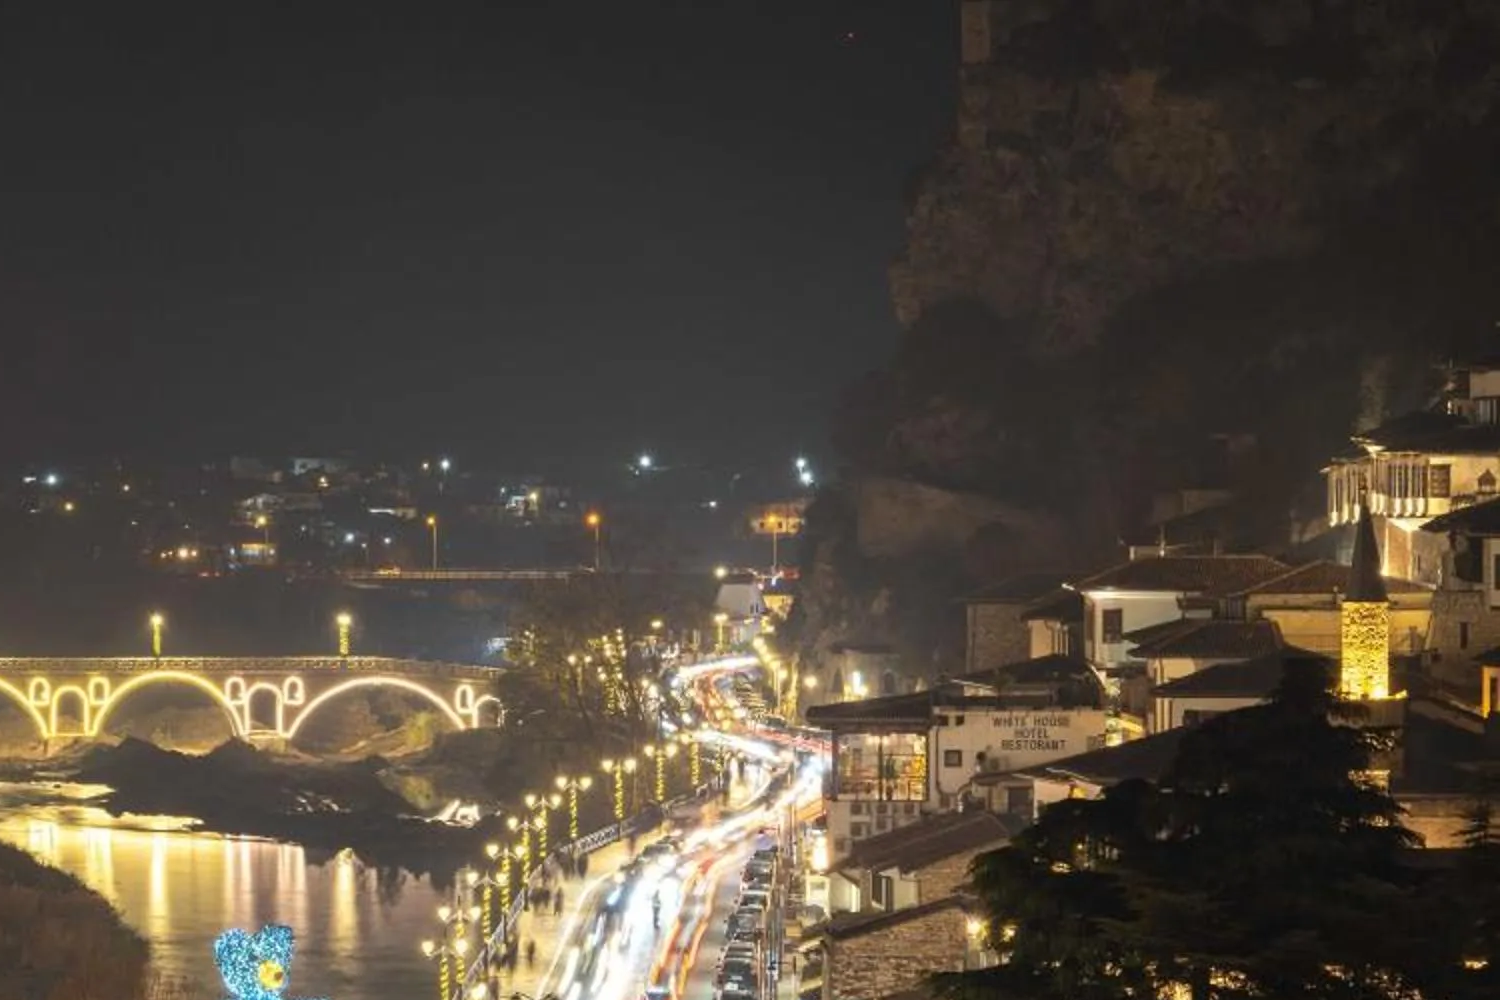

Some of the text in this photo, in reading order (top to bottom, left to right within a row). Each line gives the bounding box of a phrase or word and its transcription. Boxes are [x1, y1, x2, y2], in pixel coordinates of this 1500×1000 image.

[992, 715, 1070, 728] WHITE HOUSE
[1014, 727, 1049, 739] HOTEL
[1001, 739, 1067, 751] RESTORANT
